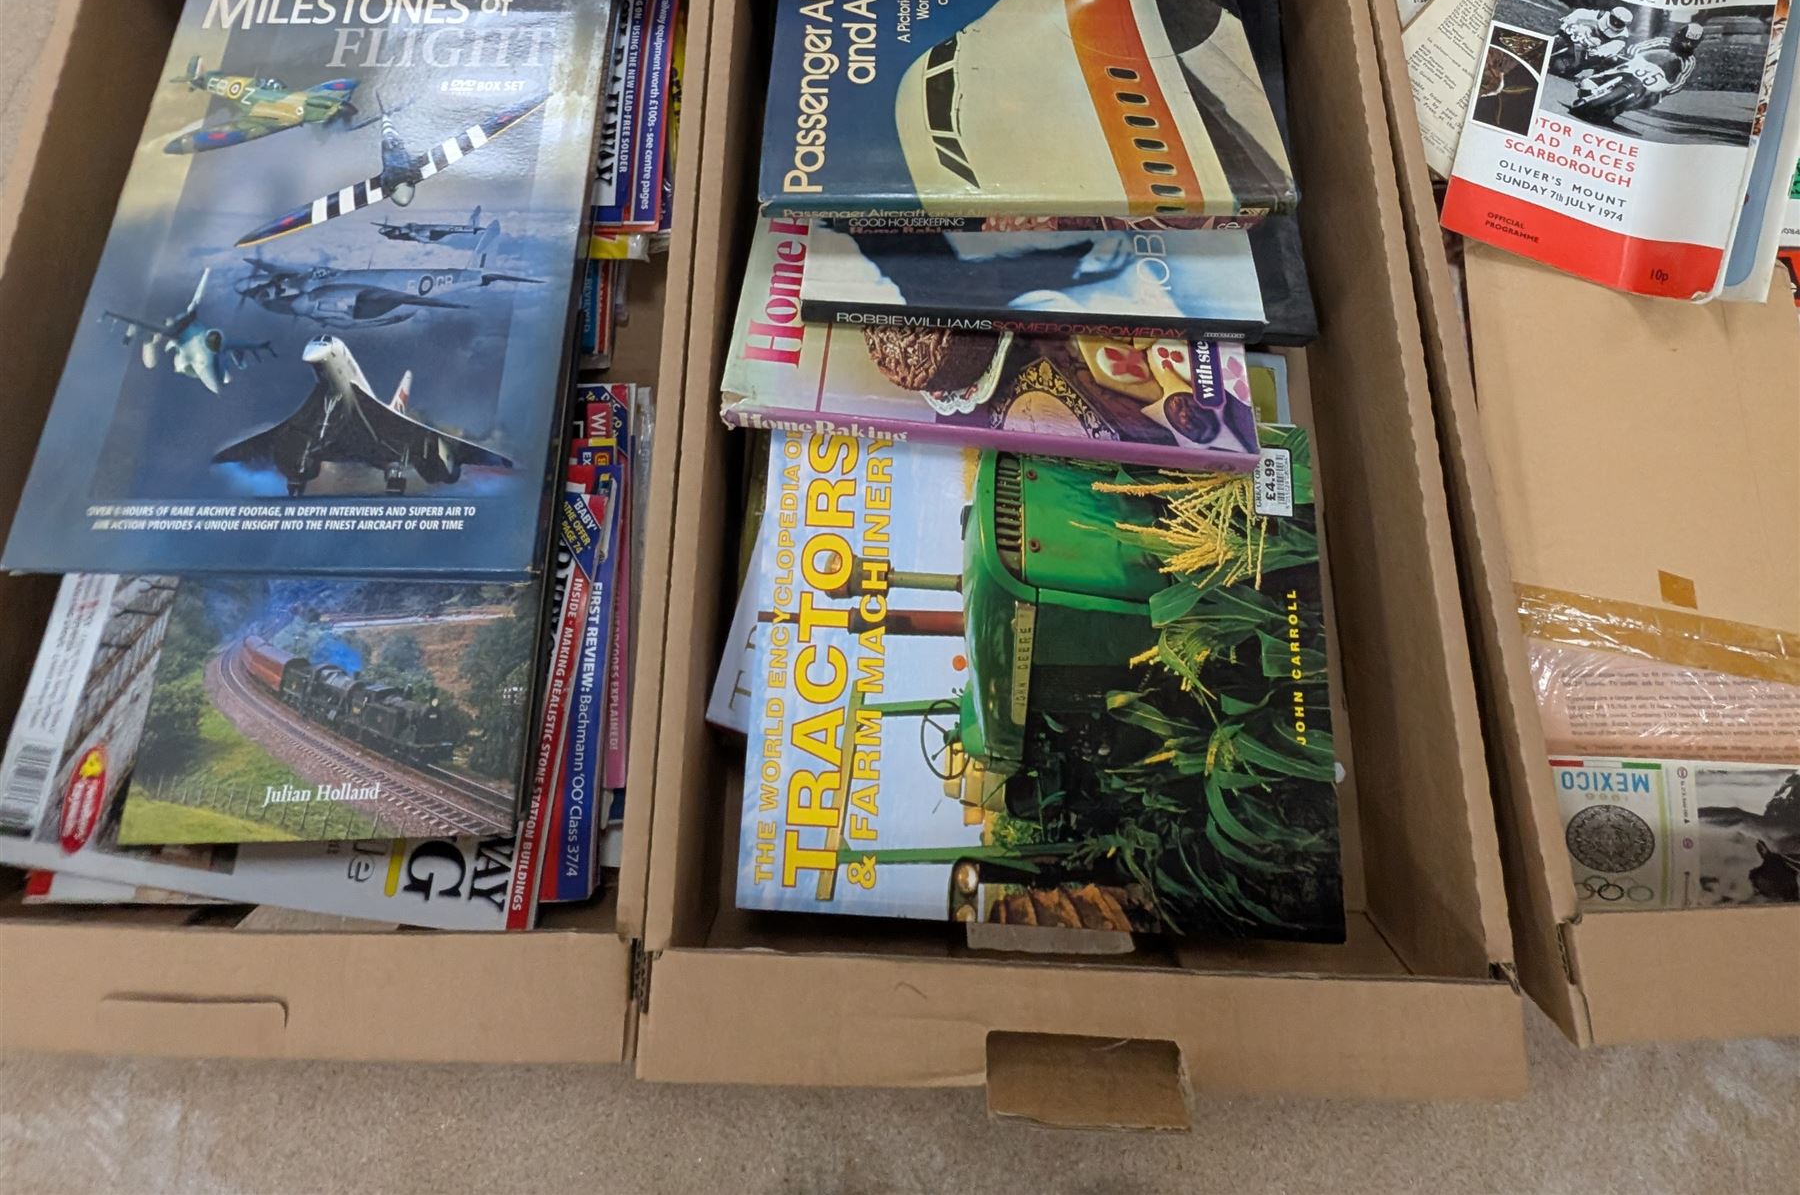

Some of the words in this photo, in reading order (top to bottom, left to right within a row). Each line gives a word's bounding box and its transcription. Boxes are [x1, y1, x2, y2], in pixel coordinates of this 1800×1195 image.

[325, 26, 558, 68] FLIGHT
[631, 25, 641, 50] USING
[652, 24, 668, 70] equipment
[841, 22, 877, 85] and
[504, 79, 526, 92] SET
[783, 24, 840, 193] Passenger
[619, 138, 631, 173] SOLDER
[1504, 138, 1633, 188] SCARBOROUGH
[1534, 133, 1561, 148] AD
[1572, 144, 1637, 173] RACES
[1582, 133, 1640, 158] CYCLE
[640, 180, 650, 211] pages
[1495, 172, 1549, 196] SUNDAY
[1550, 190, 1564, 203] 7th
[1564, 196, 1596, 213] JULY
[1598, 207, 1624, 222] 1974
[1499, 159, 1563, 187] OLIVER'S
[1571, 183, 1628, 208] MOUNT
[849, 218, 886, 227] GOOD
[888, 218, 965, 227] HOUSEKEEPING
[1485, 220, 1540, 244] PROGRAMME
[1487, 211, 1526, 230] OFFICIAL
[1650, 269, 1669, 284] 10p
[743, 240, 809, 369] Home
[1202, 364, 1214, 399] with
[1265, 458, 1276, 501] £4.99
[123, 506, 153, 517] HOURS
[170, 506, 194, 517] RARE
[196, 506, 237, 517] ARCHIVE
[238, 506, 282, 517] FOOTAGE,
[297, 506, 328, 517] DEPTH
[330, 506, 383, 517] INTERVIEWS
[385, 506, 406, 517] AND
[408, 506, 443, 517] SUPERB
[445, 506, 461, 517] AIR
[463, 506, 476, 517] TO
[147, 519, 192, 531] PROVIDES
[204, 519, 239, 531] UNIQUE
[241, 519, 279, 531] INSIGHT
[281, 519, 303, 531] INTO
[305, 519, 322, 531] THE
[324, 519, 356, 531] FINEST
[357, 519, 403, 531] AIRCRAFT
[404, 519, 418, 531] OF
[419, 519, 439, 531] OUR
[440, 519, 464, 531] TIME
[768, 464, 801, 688] ENCYCLOPEDIA
[856, 438, 895, 694] MACHINERY
[566, 577, 584, 618] INSIDE
[588, 581, 603, 625] FIRST
[555, 627, 575, 676] MAKING
[1287, 589, 1303, 680] CARROLL
[580, 625, 599, 691] REVIEW:
[782, 435, 860, 887] TRACTORS
[541, 677, 564, 743] REALISTIC
[1295, 690, 1307, 746] JOHN
[572, 694, 592, 771] Bachmann
[534, 744, 552, 786] STONE
[759, 698, 785, 812] WORLD
[850, 710, 883, 840] FARM
[263, 785, 309, 807] Julian
[314, 782, 380, 803] Holland
[1561, 770, 1650, 793] MEXICO
[524, 786, 544, 839] STATION
[568, 805, 583, 842] Class
[564, 843, 580, 877] 37/4
[754, 821, 777, 885] THE
[847, 855, 878, 890] &
[511, 840, 534, 912] BUILDINGS
